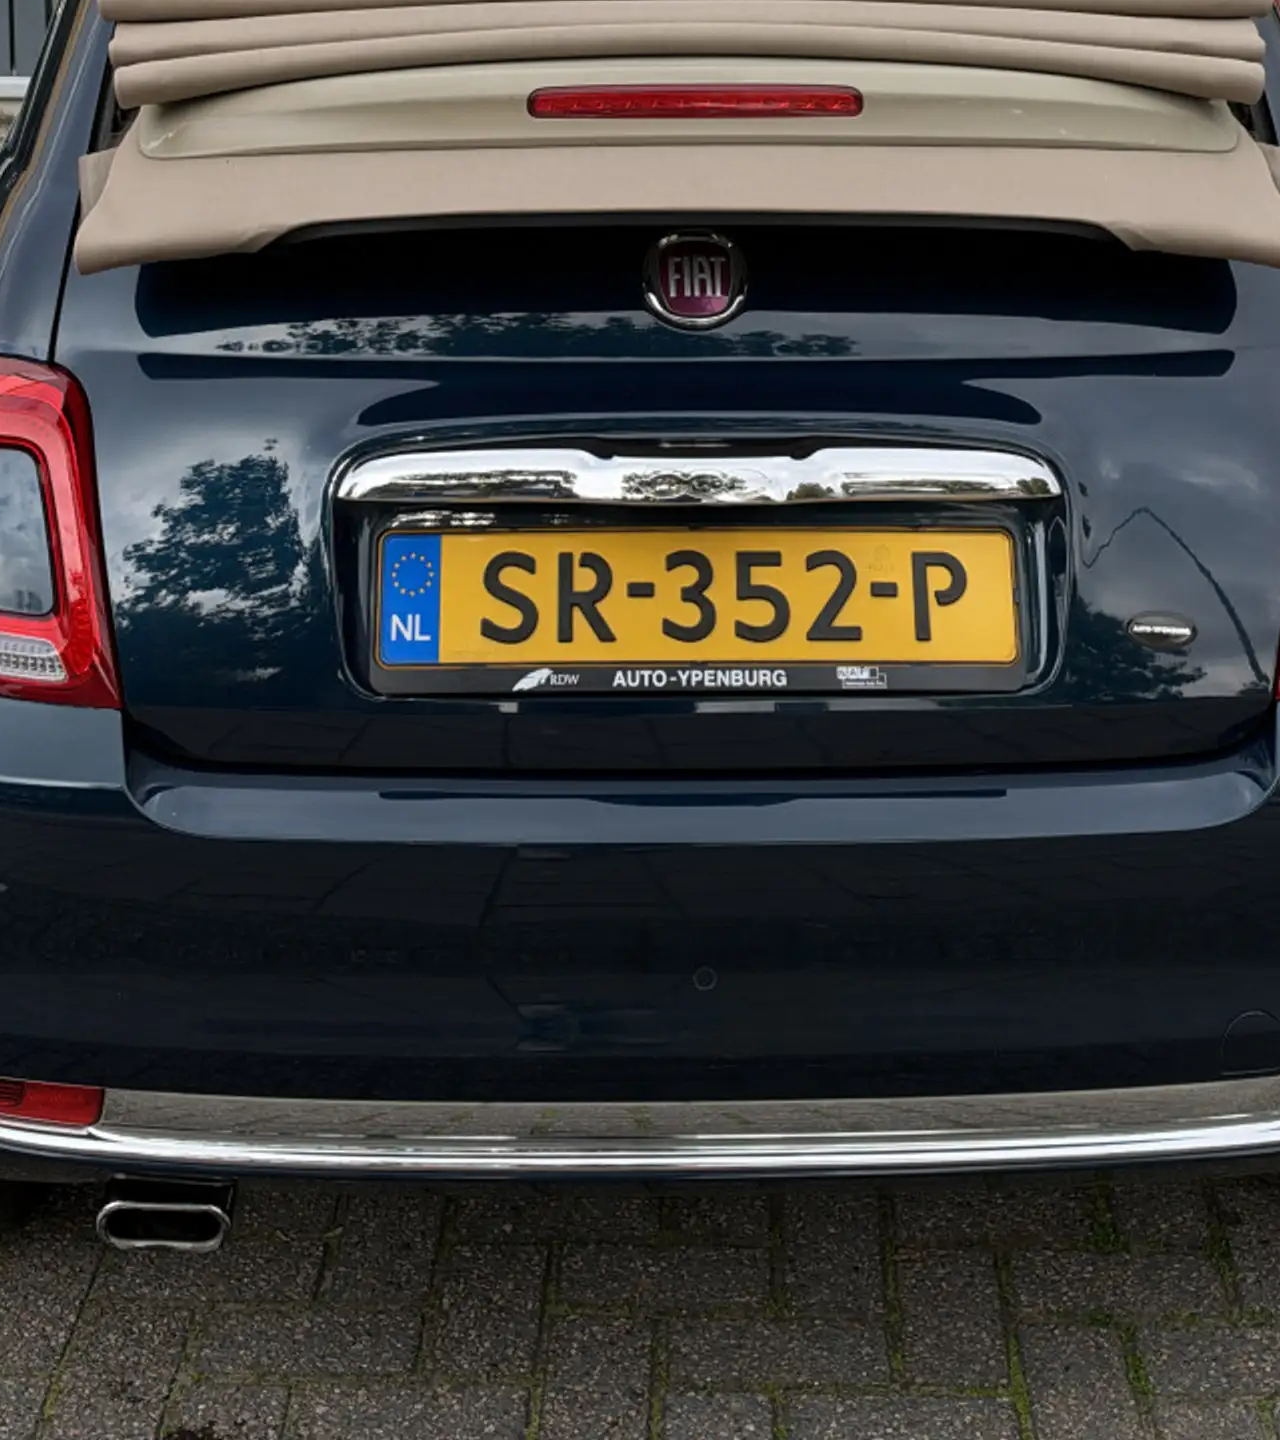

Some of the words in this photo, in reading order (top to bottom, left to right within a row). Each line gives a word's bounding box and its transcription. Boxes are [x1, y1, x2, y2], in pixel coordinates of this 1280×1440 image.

[668, 255, 727, 298] FIAT
[390, 613, 432, 642] NL
[479, 549, 968, 645] SR-352-P
[549, 673, 580, 686] RDW
